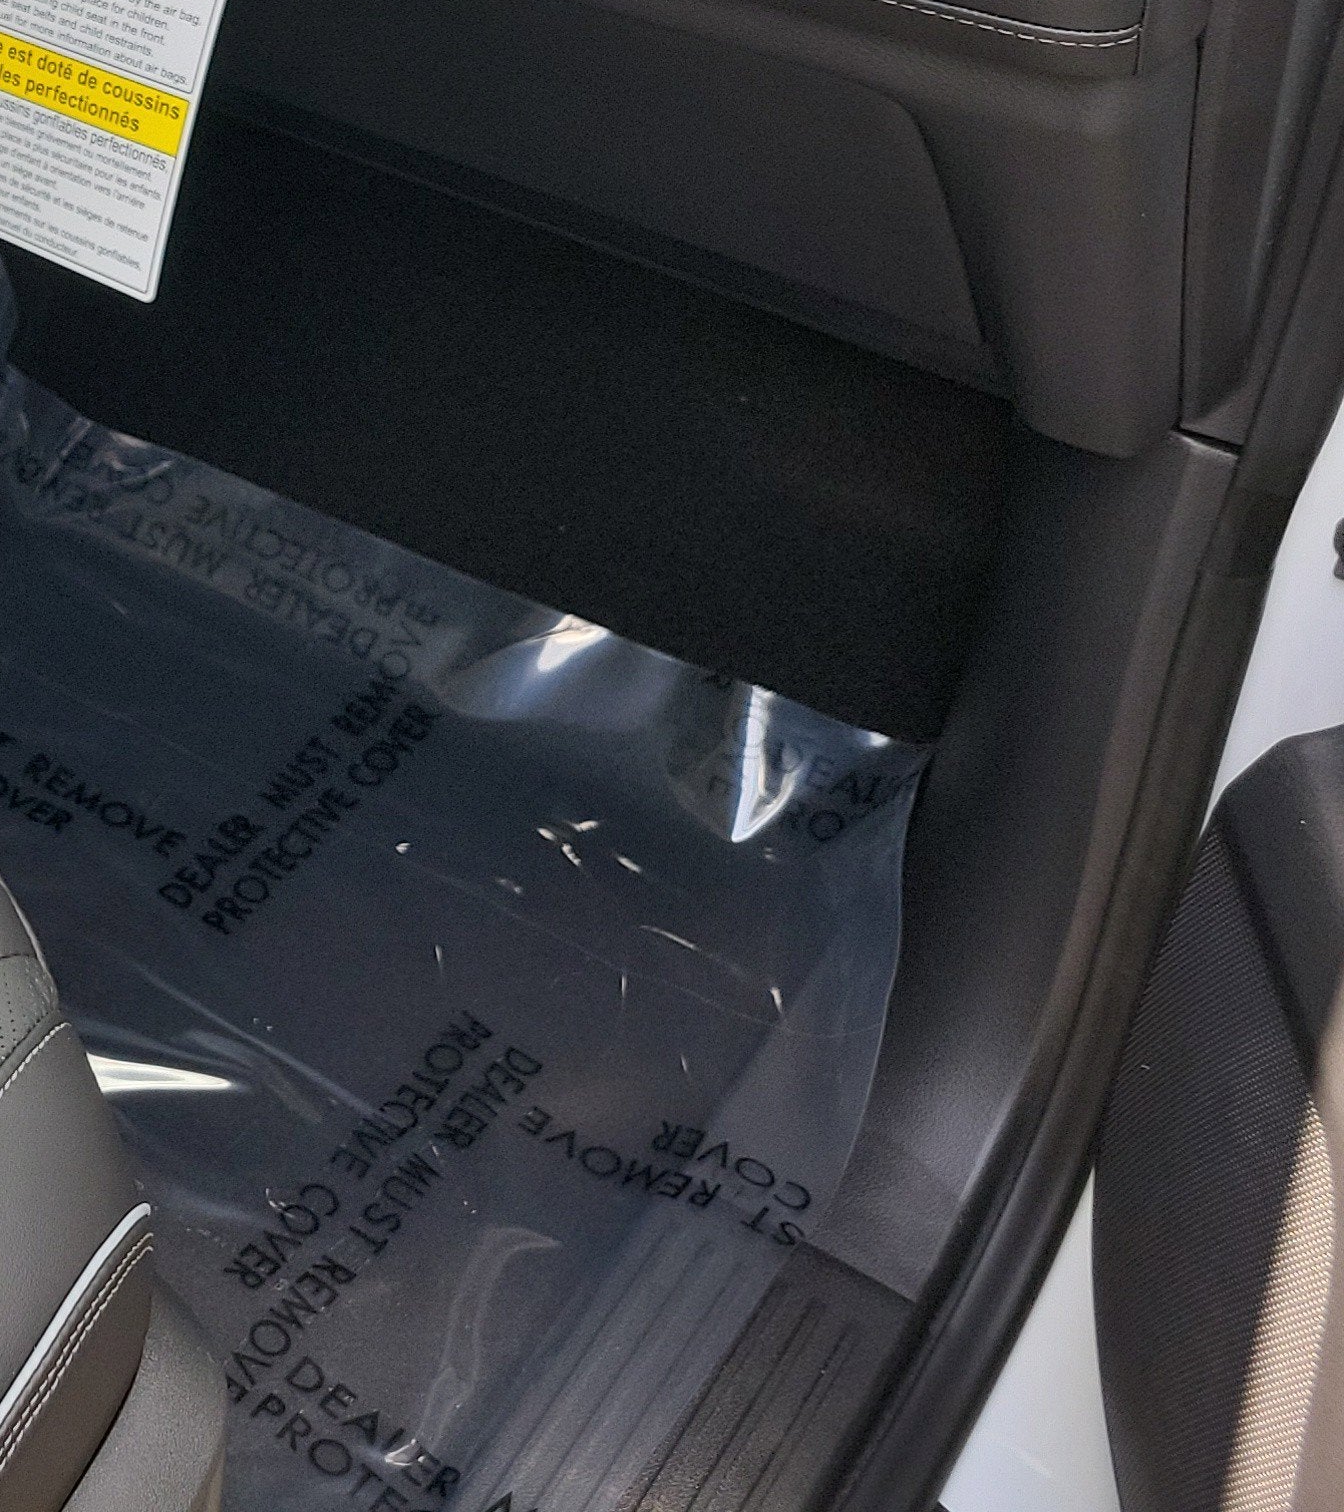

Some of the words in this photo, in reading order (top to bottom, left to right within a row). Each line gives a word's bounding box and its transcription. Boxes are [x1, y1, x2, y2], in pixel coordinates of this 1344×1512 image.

[8, 46, 34, 65] est
[37, 52, 74, 80] doté
[77, 67, 98, 90] de
[102, 80, 181, 120] coussins
[24, 79, 140, 133] perfectionnés
[33, 111, 88, 141] gonflables
[117, 512, 234, 577] MUST
[244, 566, 380, 661] DEALER
[22, 751, 188, 860] REMOVE
[155, 813, 267, 911] DEALER
[256, 736, 342, 812] MUST
[199, 784, 362, 937] PROTECTIVE
[346, 699, 444, 788] COVER
[328, 1008, 495, 1182] PROTECTIVE
[434, 1044, 546, 1151] DEALER
[347, 1151, 446, 1257] MUST
[516, 1104, 723, 1213] REMOVE
[650, 1118, 813, 1217] COVER
[221, 1181, 342, 1292] COVER
[248, 1391, 414, 1512] PROTE
